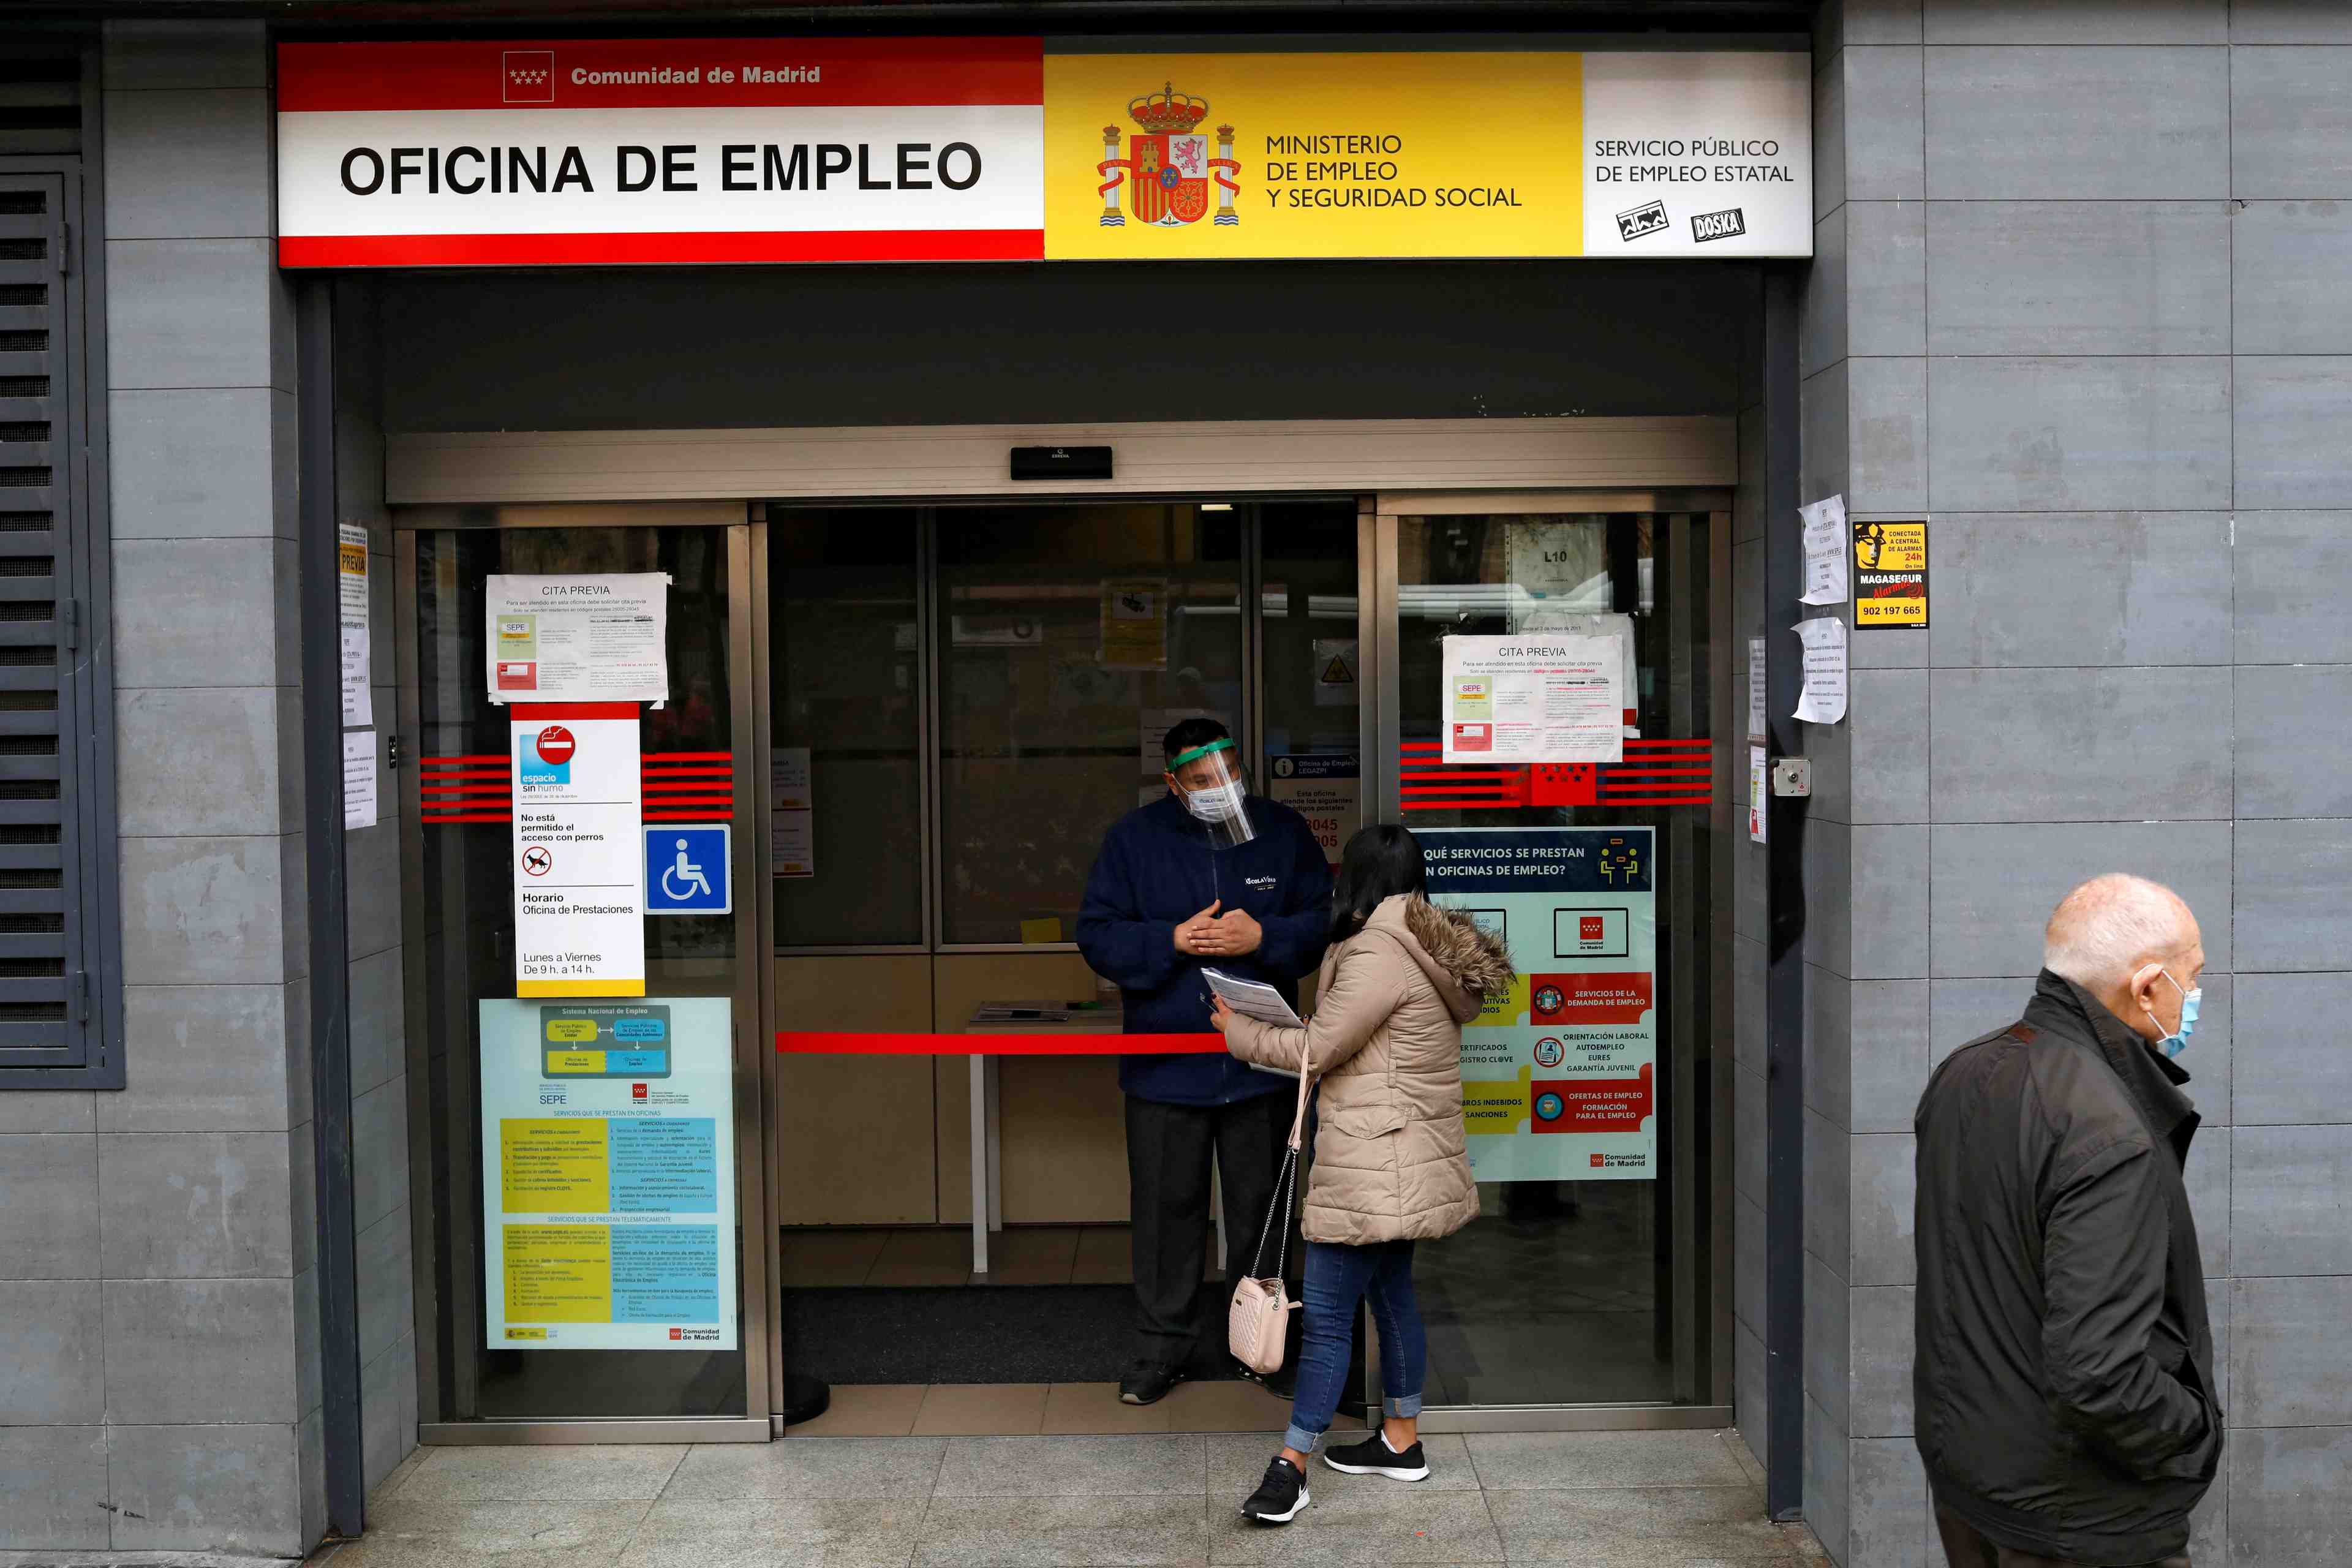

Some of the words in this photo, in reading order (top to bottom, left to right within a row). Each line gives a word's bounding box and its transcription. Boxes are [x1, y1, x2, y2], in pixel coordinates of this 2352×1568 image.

[571, 67, 699, 85] Comunidad
[704, 67, 735, 85] de
[742, 66, 821, 83] Madrid
[1267, 135, 1401, 155] MINISTERIO
[1596, 140, 1684, 156] SERVICIO
[1692, 137, 1779, 156] PÚBLICO
[341, 146, 594, 197] OFICINA
[617, 145, 698, 192] DE
[722, 141, 982, 192] EMPLEO
[1267, 162, 1298, 181] DE
[1306, 161, 1397, 181] EMPLEO
[1596, 166, 1623, 182] DE
[1630, 165, 1707, 182] EMPLEO
[1715, 165, 1794, 182] ESTATAL
[1266, 189, 1280, 208] Y
[1289, 187, 1427, 208] SEGURIDAD
[1434, 186, 1522, 207] SOCIAL
[1694, 212, 1741, 238] DOSKA
[1544, 551, 1567, 563] L10
[342, 554, 366, 571] PREVIA
[1860, 575, 1922, 584] MAGASEGUR
[542, 586, 567, 595] CITA
[570, 586, 610, 595] PREVIA
[1904, 606, 1920, 614] 665
[1499, 647, 1523, 657] CITA
[1527, 647, 1566, 657] PREVIA
[522, 773, 556, 784] espacio
[522, 783, 535, 792] sin
[521, 824, 564, 832] permitido
[1306, 819, 1338, 831] 8045
[575, 834, 604, 842] perros
[1423, 846, 1447, 861] QUÉ
[1451, 848, 1512, 859] SERVICIOS
[1516, 848, 1529, 858] SE
[1532, 848, 1585, 858] PRESTAN
[1425, 867, 1434, 876] N
[1438, 866, 1493, 876] OFICINAS
[1496, 866, 1510, 875] DE
[1513, 865, 1566, 875] EMPLEO?
[523, 894, 564, 903] Horario
[523, 905, 556, 914] Oficina
[558, 905, 570, 914] de
[573, 904, 633, 914] Prestaciones
[524, 953, 553, 962] Lunes
[565, 953, 601, 962] Viernes
[524, 965, 538, 974] De
[540, 965, 547, 974] 9
[549, 965, 560, 974] h.
[571, 965, 582, 973] 14
[1564, 1031, 1613, 1040] ORIENTACIÓN
[1567, 1063, 1605, 1072] GARANTÍA
[540, 1095, 567, 1104] SEPE
[1583, 1102, 1627, 1110] FORMACIÓN
